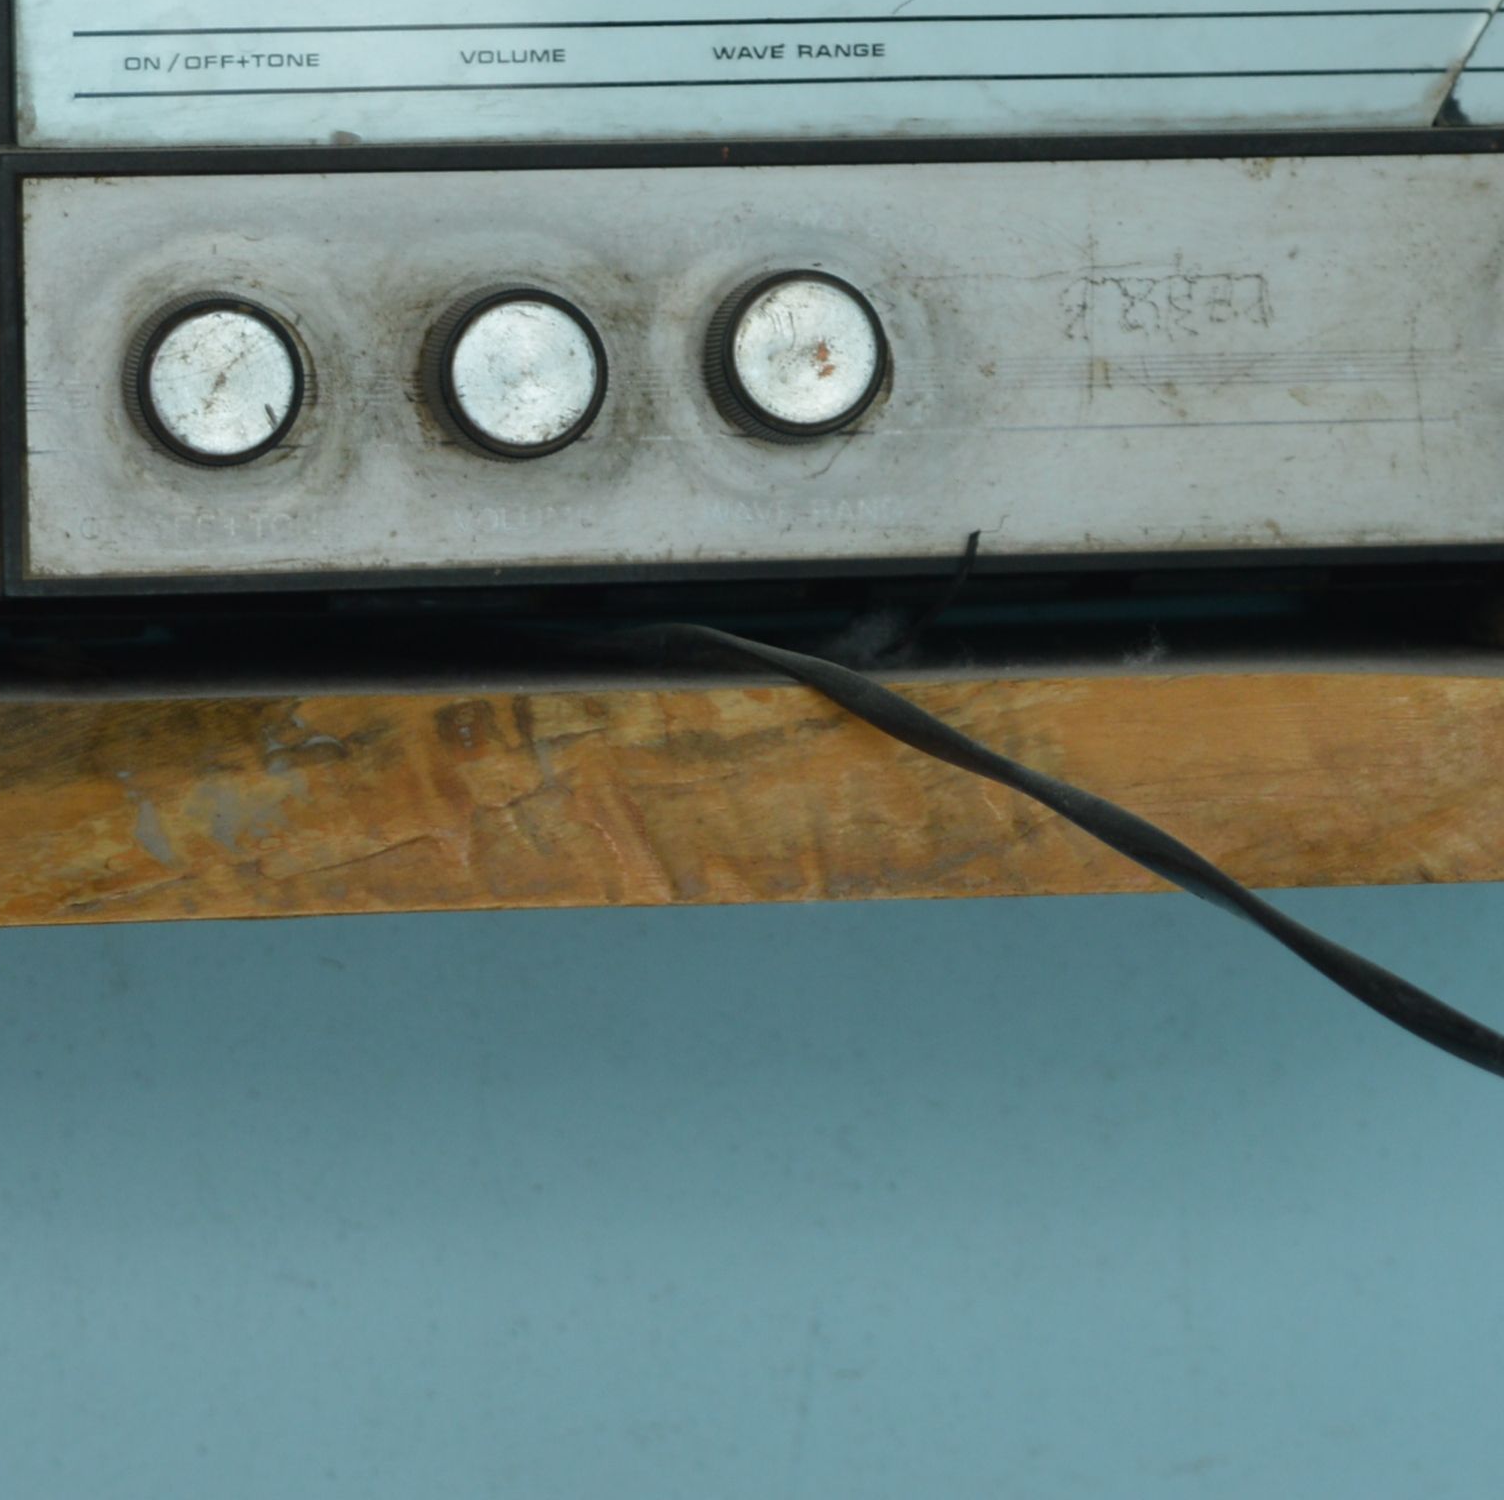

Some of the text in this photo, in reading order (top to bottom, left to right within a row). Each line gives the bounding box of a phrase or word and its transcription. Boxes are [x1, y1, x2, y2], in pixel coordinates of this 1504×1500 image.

[460, 47, 566, 65] VOLUME
[712, 42, 885, 61] WAVE RANGE
